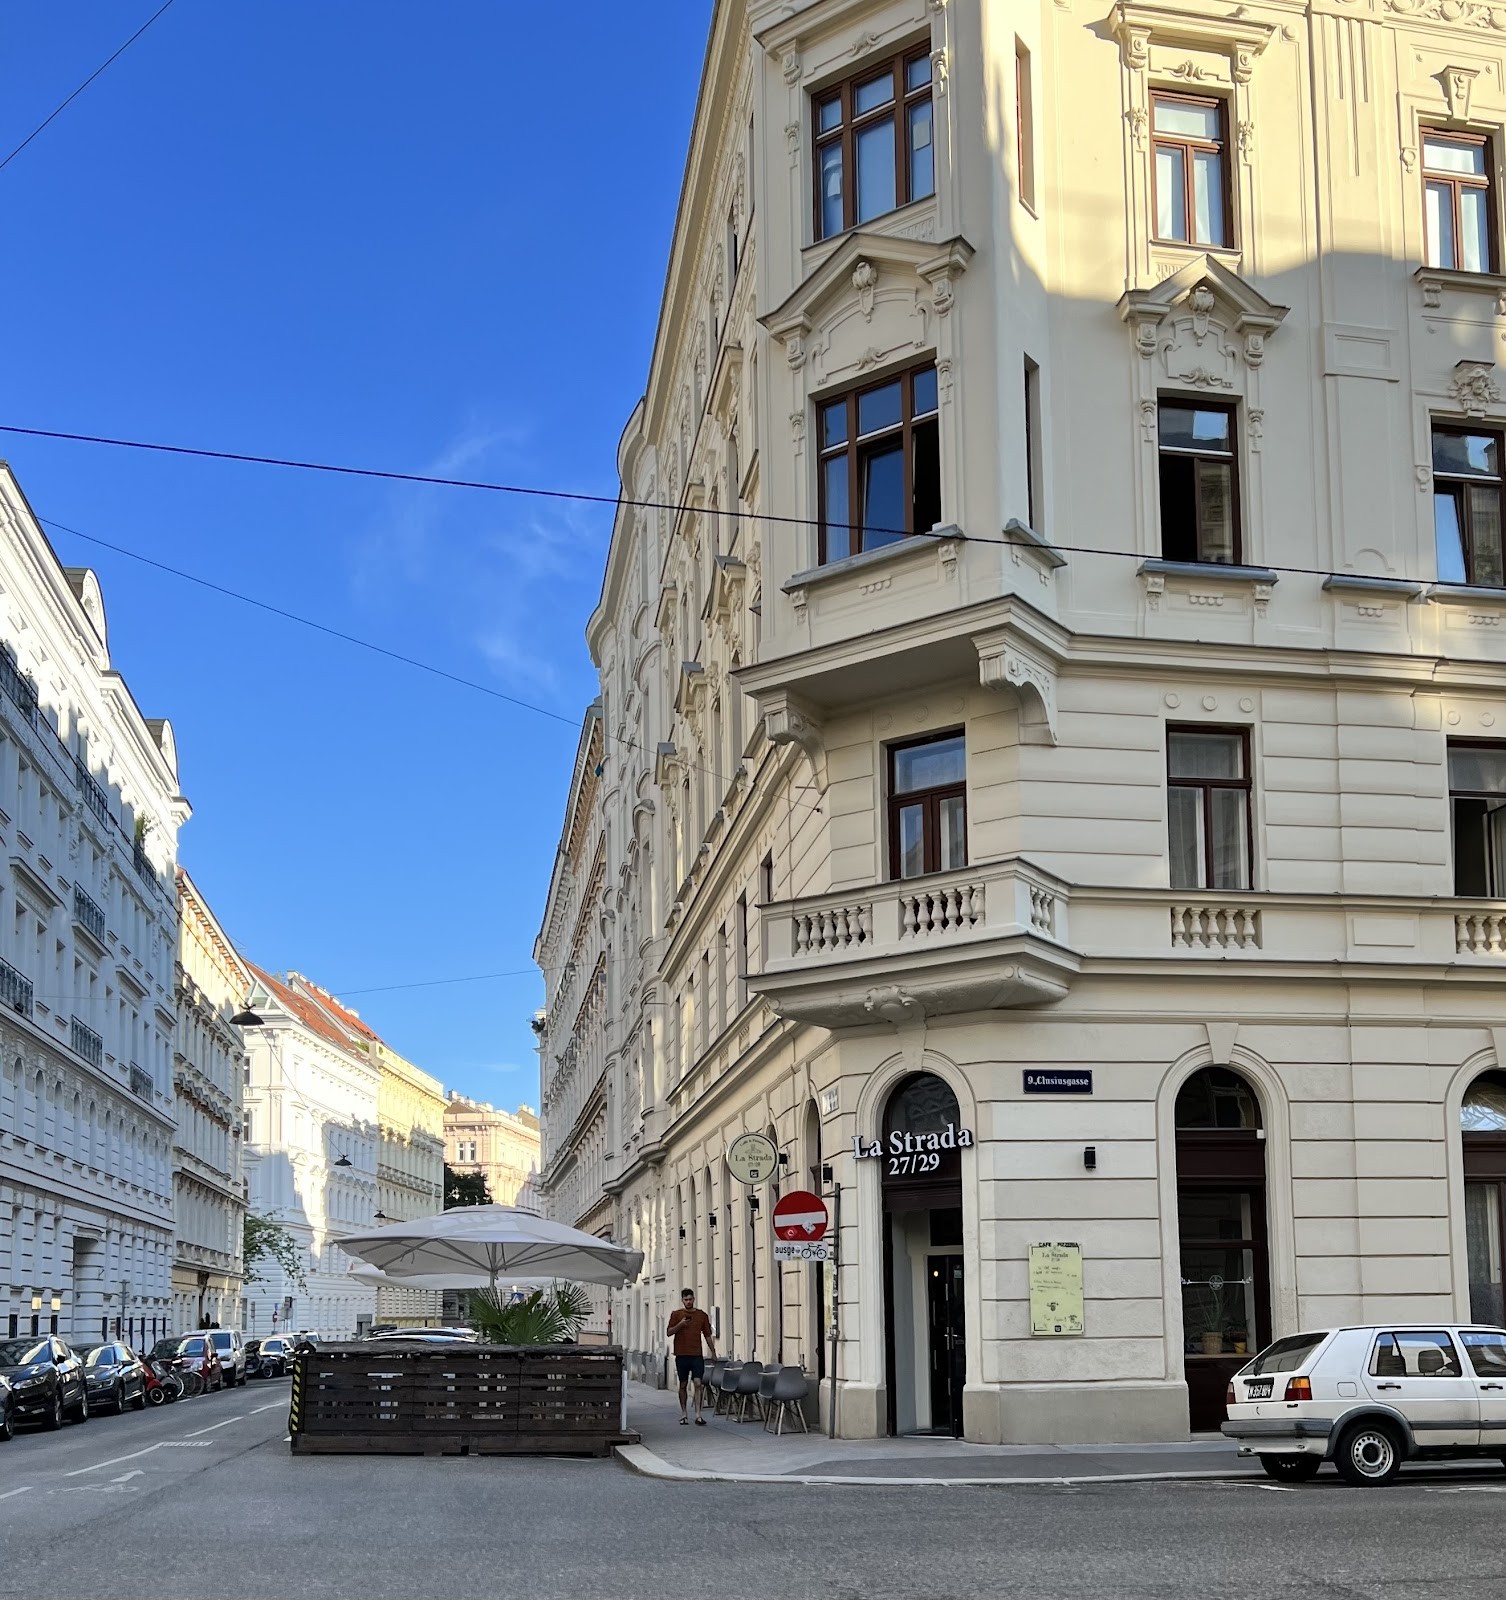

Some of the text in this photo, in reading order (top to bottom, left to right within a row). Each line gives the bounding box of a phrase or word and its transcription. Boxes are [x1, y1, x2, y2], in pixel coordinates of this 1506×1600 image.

[851, 1123, 974, 1159] La Strada
[888, 1152, 940, 1175] 27/29
